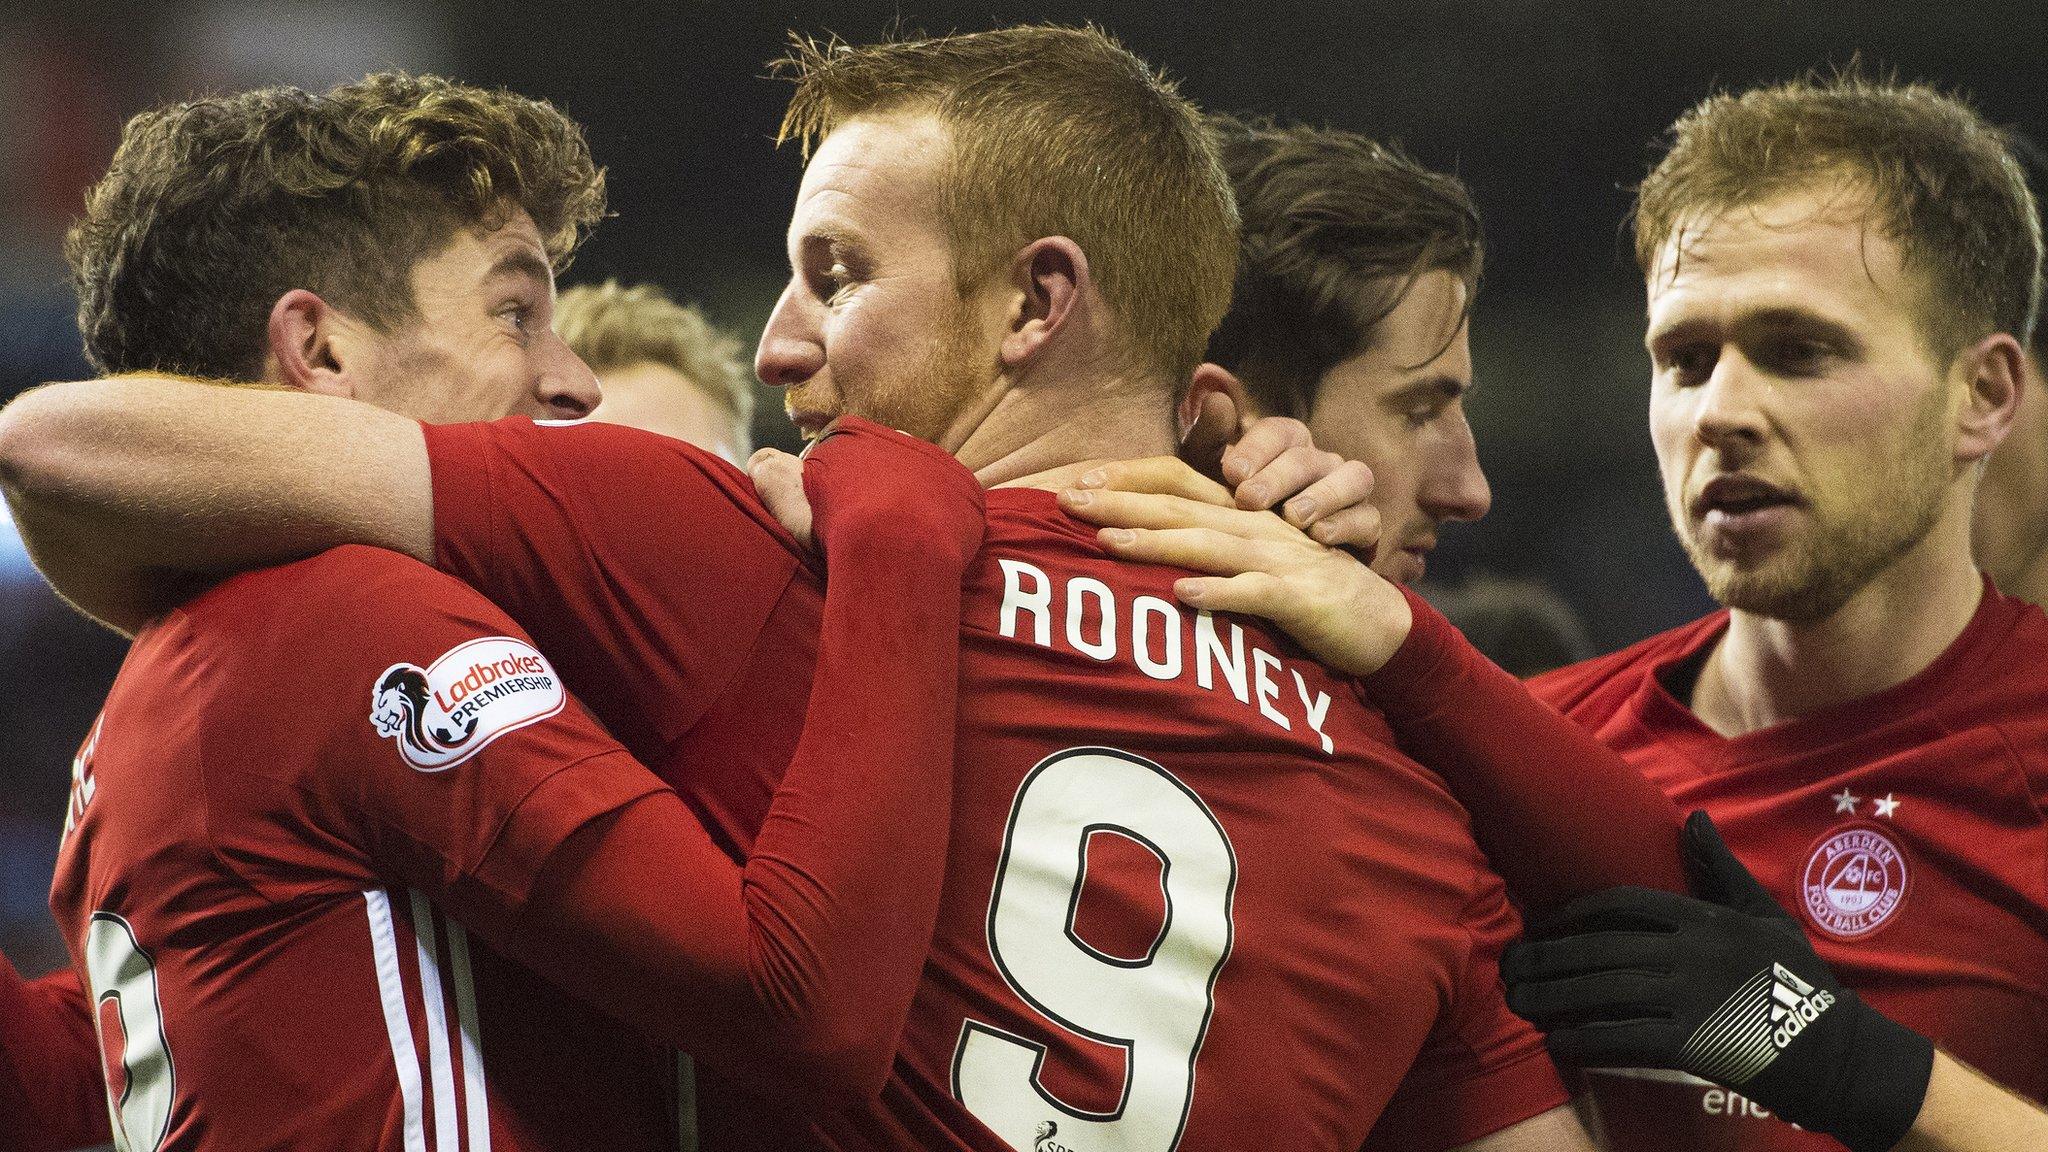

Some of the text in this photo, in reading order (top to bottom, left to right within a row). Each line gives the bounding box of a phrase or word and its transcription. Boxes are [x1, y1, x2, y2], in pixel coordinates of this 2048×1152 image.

[434, 653, 545, 714] Ladbrokes
[998, 559, 1334, 755] ROONEY
[450, 675, 553, 727] PREMIERSHIP
[1825, 834, 1894, 866] ABERDEEN
[1809, 883, 1899, 930] FOOTBALL CLUB
[950, 746, 1238, 1152] 9
[1773, 989, 1836, 1048] adidas
